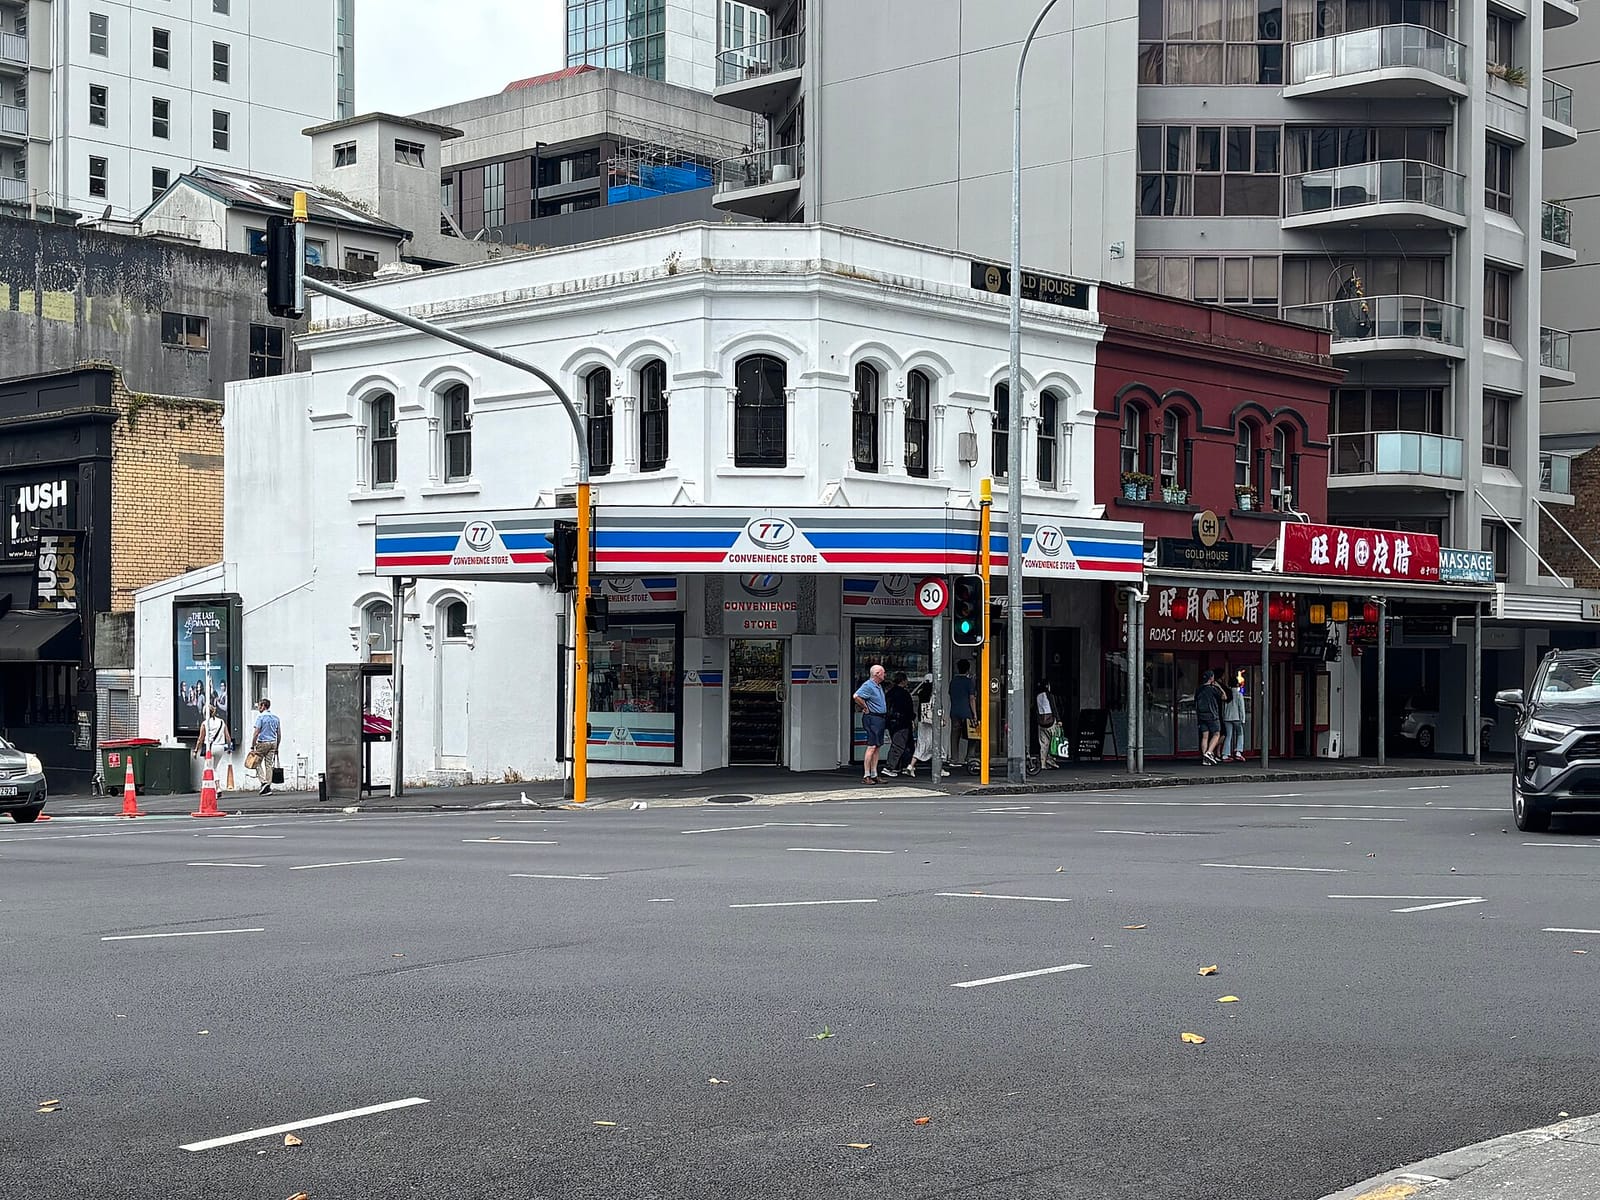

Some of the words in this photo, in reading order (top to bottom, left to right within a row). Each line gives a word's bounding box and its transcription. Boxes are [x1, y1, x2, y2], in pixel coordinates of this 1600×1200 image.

[1040, 278, 1076, 297] HOUSE
[760, 524, 785, 539] 77
[1202, 520, 1216, 534] GH
[472, 527, 488, 542] 77
[1042, 531, 1058, 547] 77
[454, 556, 490, 566] CONVENIENCE
[491, 555, 509, 565] STORE
[729, 554, 789, 564] CONVENIENCE
[790, 554, 818, 563] STORE
[1185, 549, 1205, 559] GOLD
[1206, 550, 1229, 561] HOUSE
[1439, 552, 1492, 571] MASSAGE
[1024, 559, 1059, 570] CONVENIENCE
[1060, 561, 1076, 570] STORE
[922, 588, 940, 603] 30
[724, 601, 797, 612] CONVENIENCE
[202, 611, 215, 620] LAST
[743, 620, 777, 630] STORE
[1150, 627, 1177, 642] ROAST
[1181, 628, 1204, 643] HOUSE
[1217, 630, 1244, 644] CHINESE
